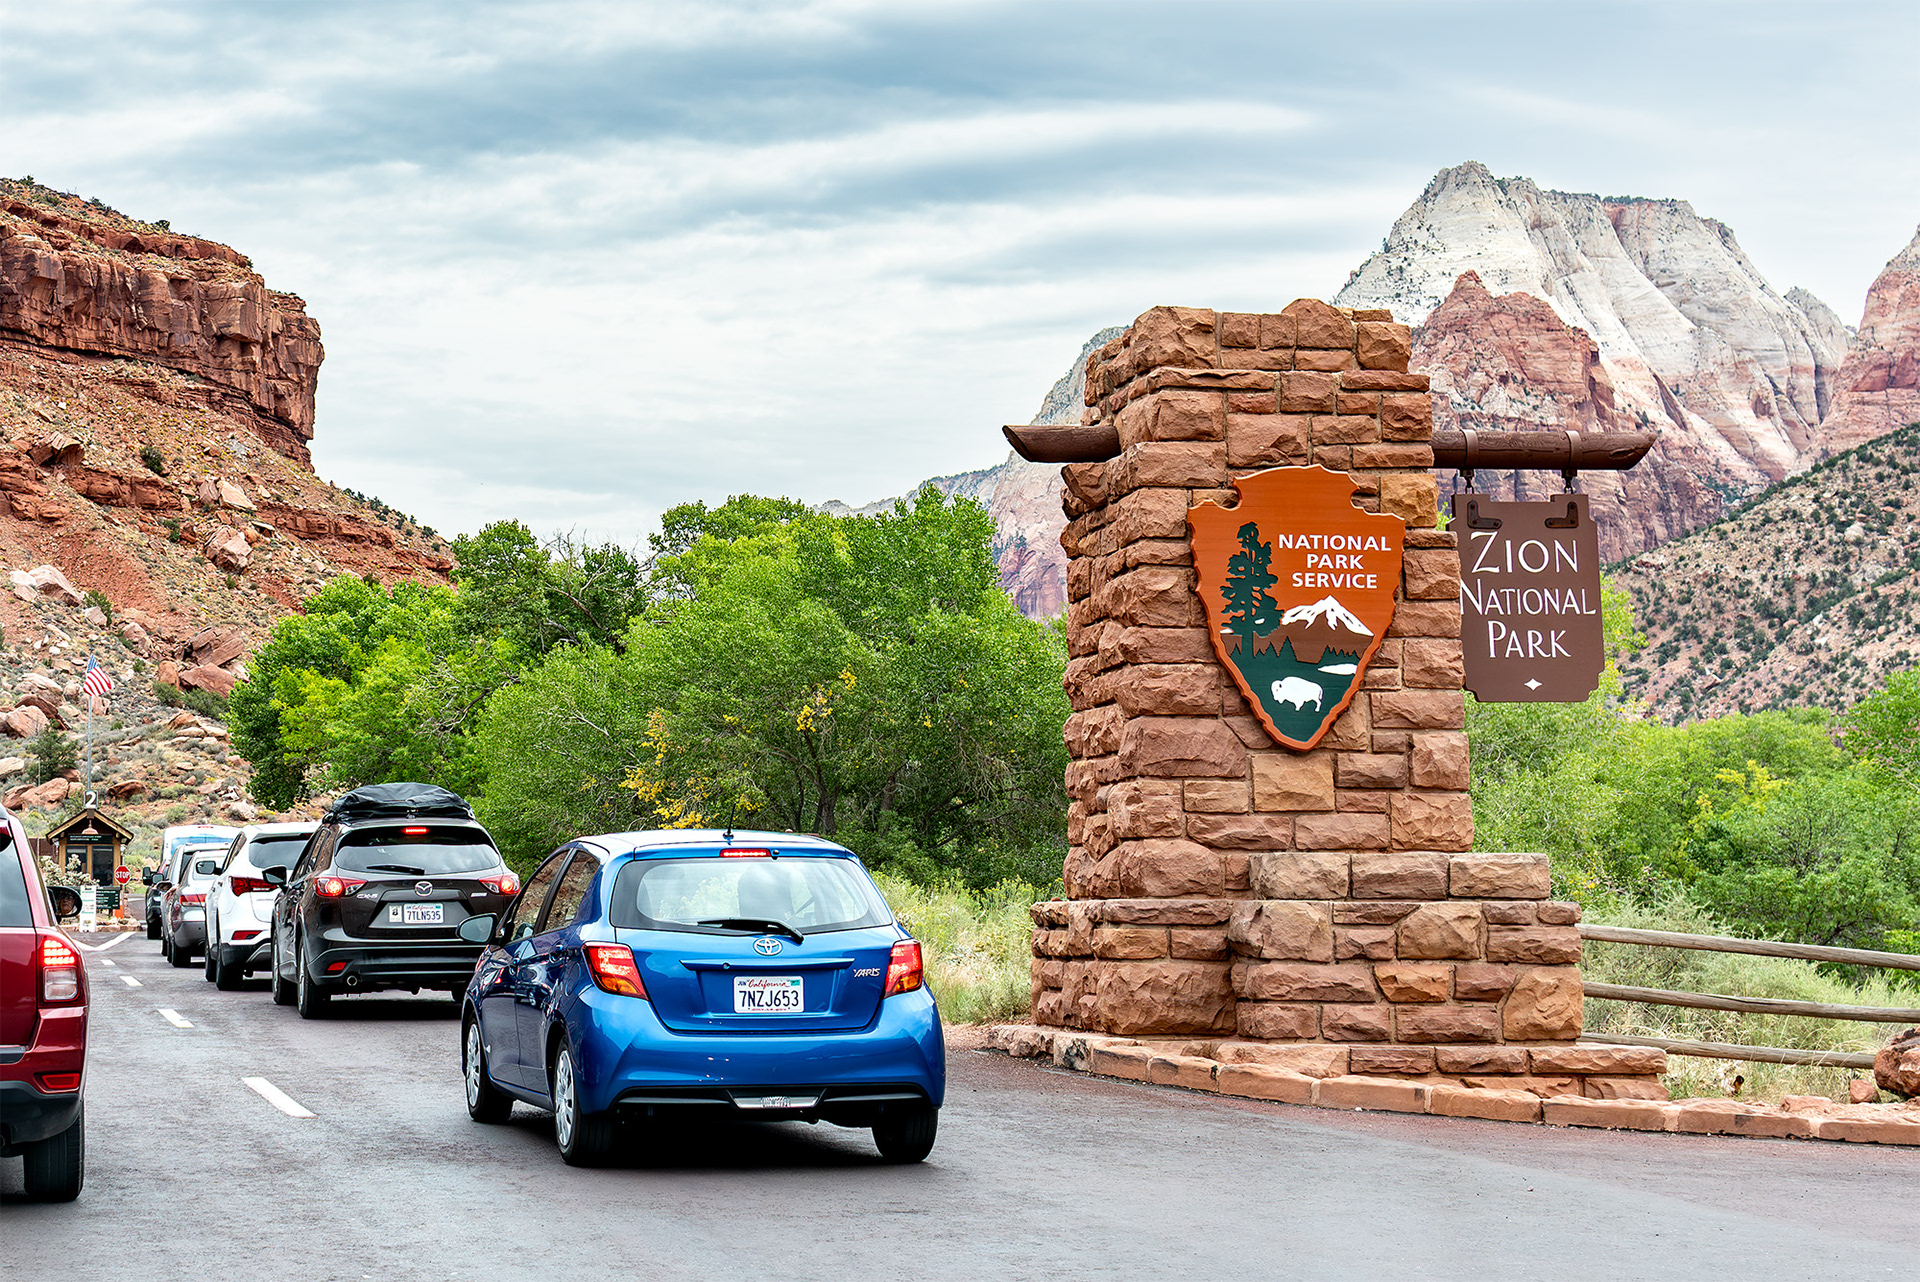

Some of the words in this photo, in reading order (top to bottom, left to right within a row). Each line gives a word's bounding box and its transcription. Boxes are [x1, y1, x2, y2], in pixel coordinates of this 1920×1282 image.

[1278, 534, 1392, 551] NATIONAL
[1470, 531, 1579, 574] ZION
[1306, 553, 1364, 570] PARK
[1292, 572, 1377, 589] SERVICE
[1460, 578, 1597, 616] NATIONAL
[1487, 620, 1572, 659] PARK
[86, 791, 97, 808] 2
[115, 871, 130, 879] STOP
[406, 910, 441, 921] 7TLN535
[853, 967, 880, 978] YARIS
[748, 979, 790, 990] California
[739, 990, 799, 1007] 7NZJ653
